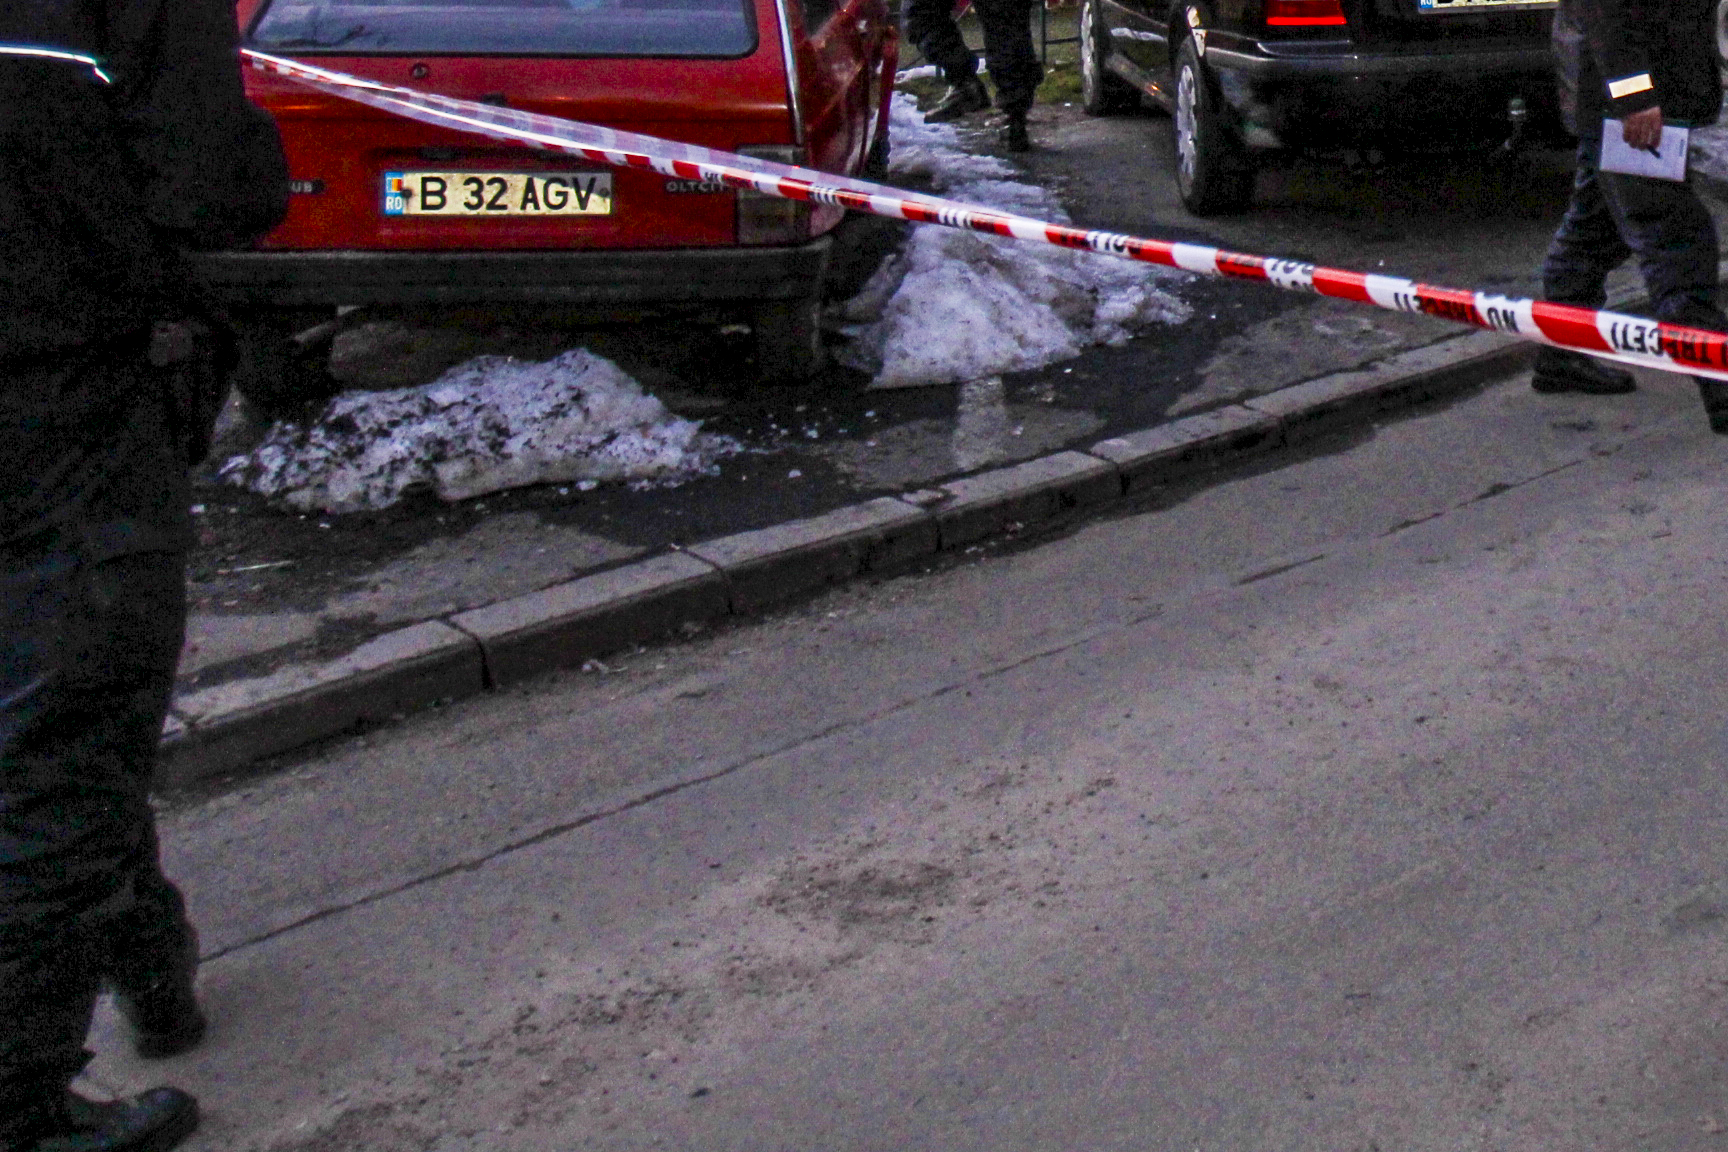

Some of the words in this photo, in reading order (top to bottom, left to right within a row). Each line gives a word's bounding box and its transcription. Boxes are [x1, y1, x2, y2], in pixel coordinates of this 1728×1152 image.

[386, 196, 403, 210] RO
[420, 176, 448, 211] B
[463, 176, 509, 211] 32
[519, 176, 598, 211] AGV
